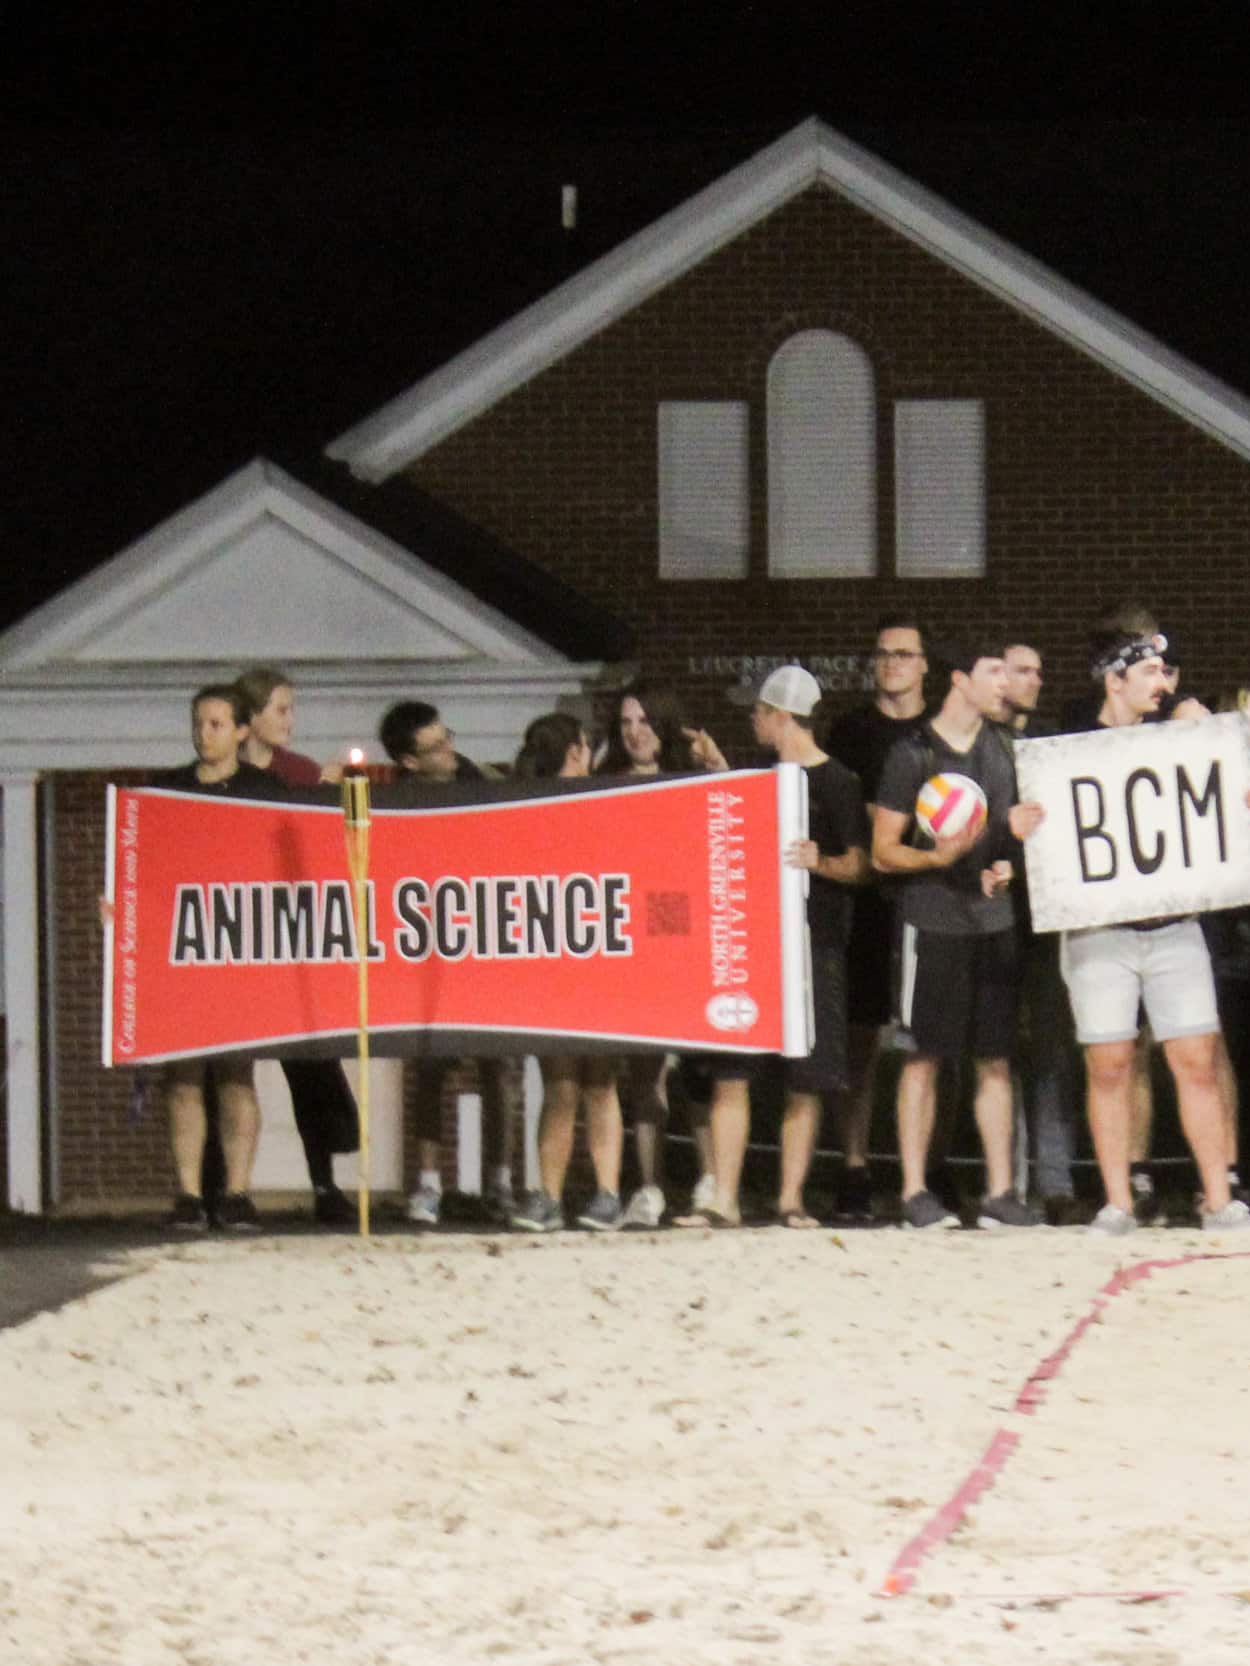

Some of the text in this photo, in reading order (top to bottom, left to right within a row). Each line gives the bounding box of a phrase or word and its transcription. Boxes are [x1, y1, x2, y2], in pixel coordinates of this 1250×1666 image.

[707, 791, 730, 986] NORTH GREENVILLE
[726, 794, 749, 984] UNIVERSITY
[1070, 760, 1227, 883] BCM
[170, 872, 632, 966] ANIMAL SCIENCE
